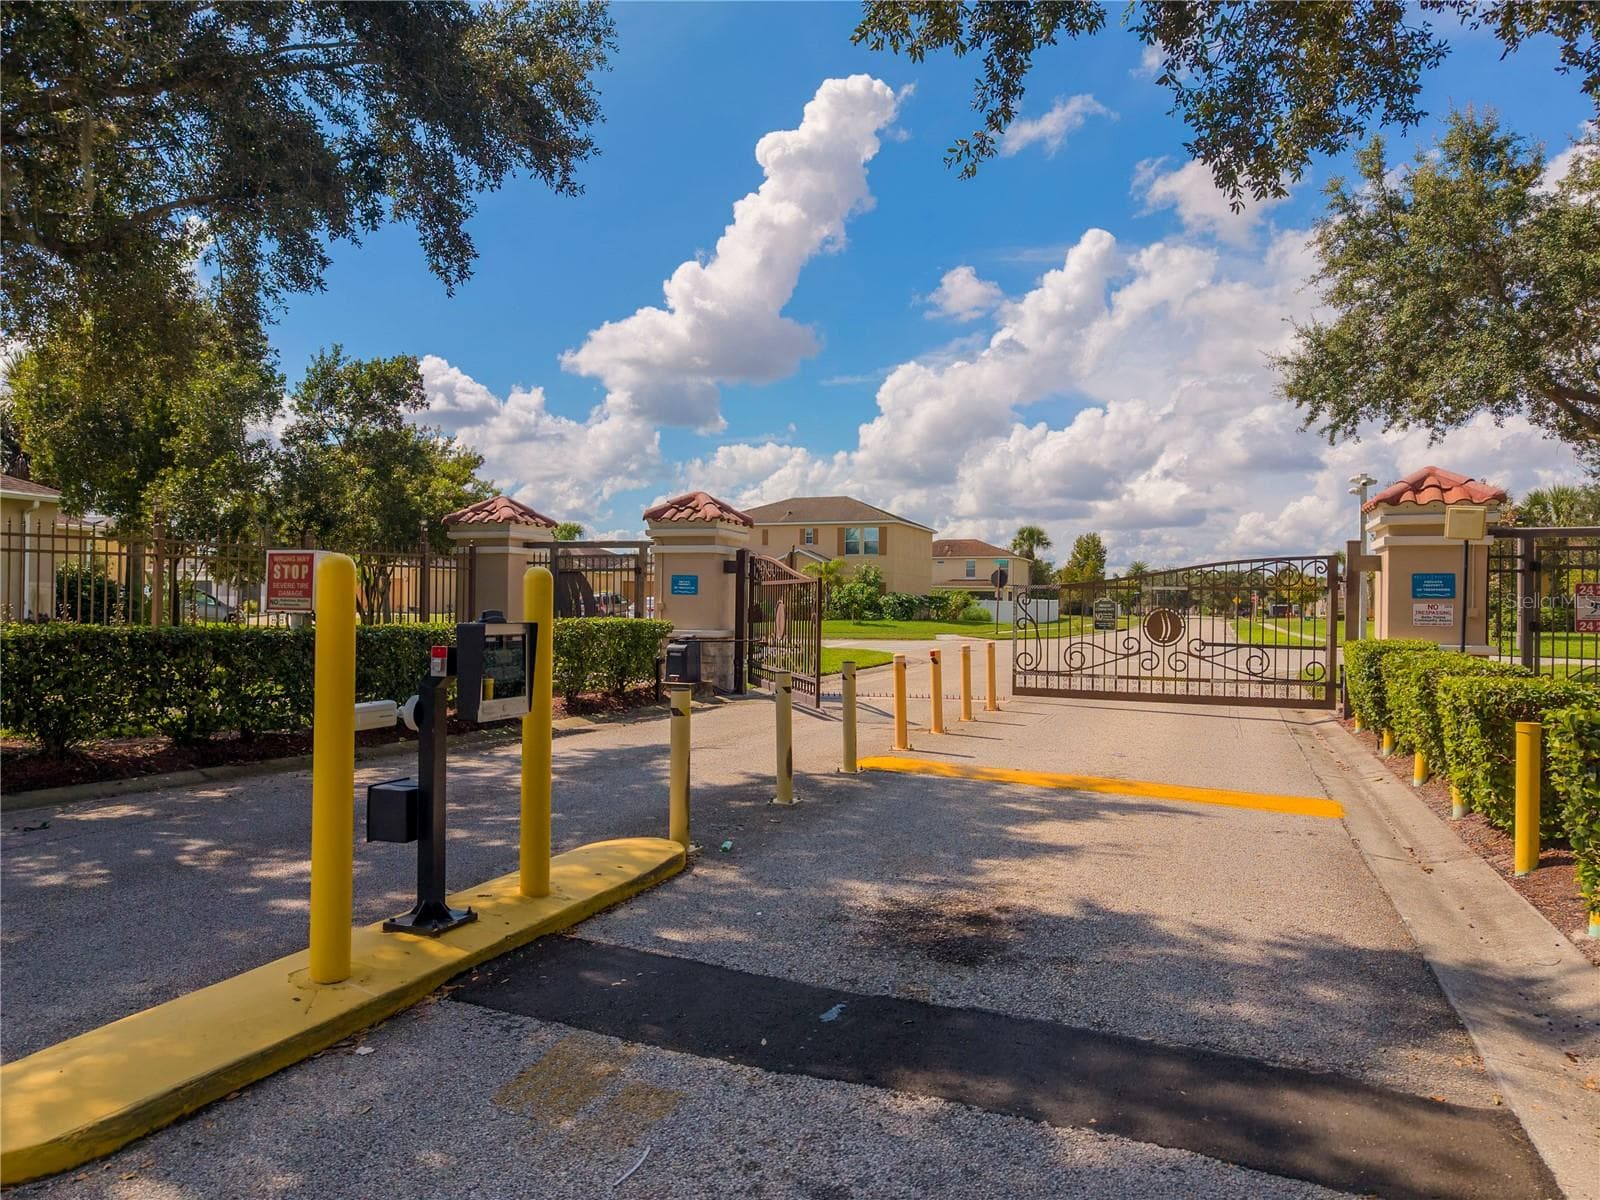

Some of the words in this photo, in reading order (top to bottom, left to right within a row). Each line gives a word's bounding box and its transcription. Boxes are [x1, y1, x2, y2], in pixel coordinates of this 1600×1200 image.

[273, 564, 309, 579] STOP
[1579, 585, 1593, 595] 24
[1579, 621, 1593, 631] 24
